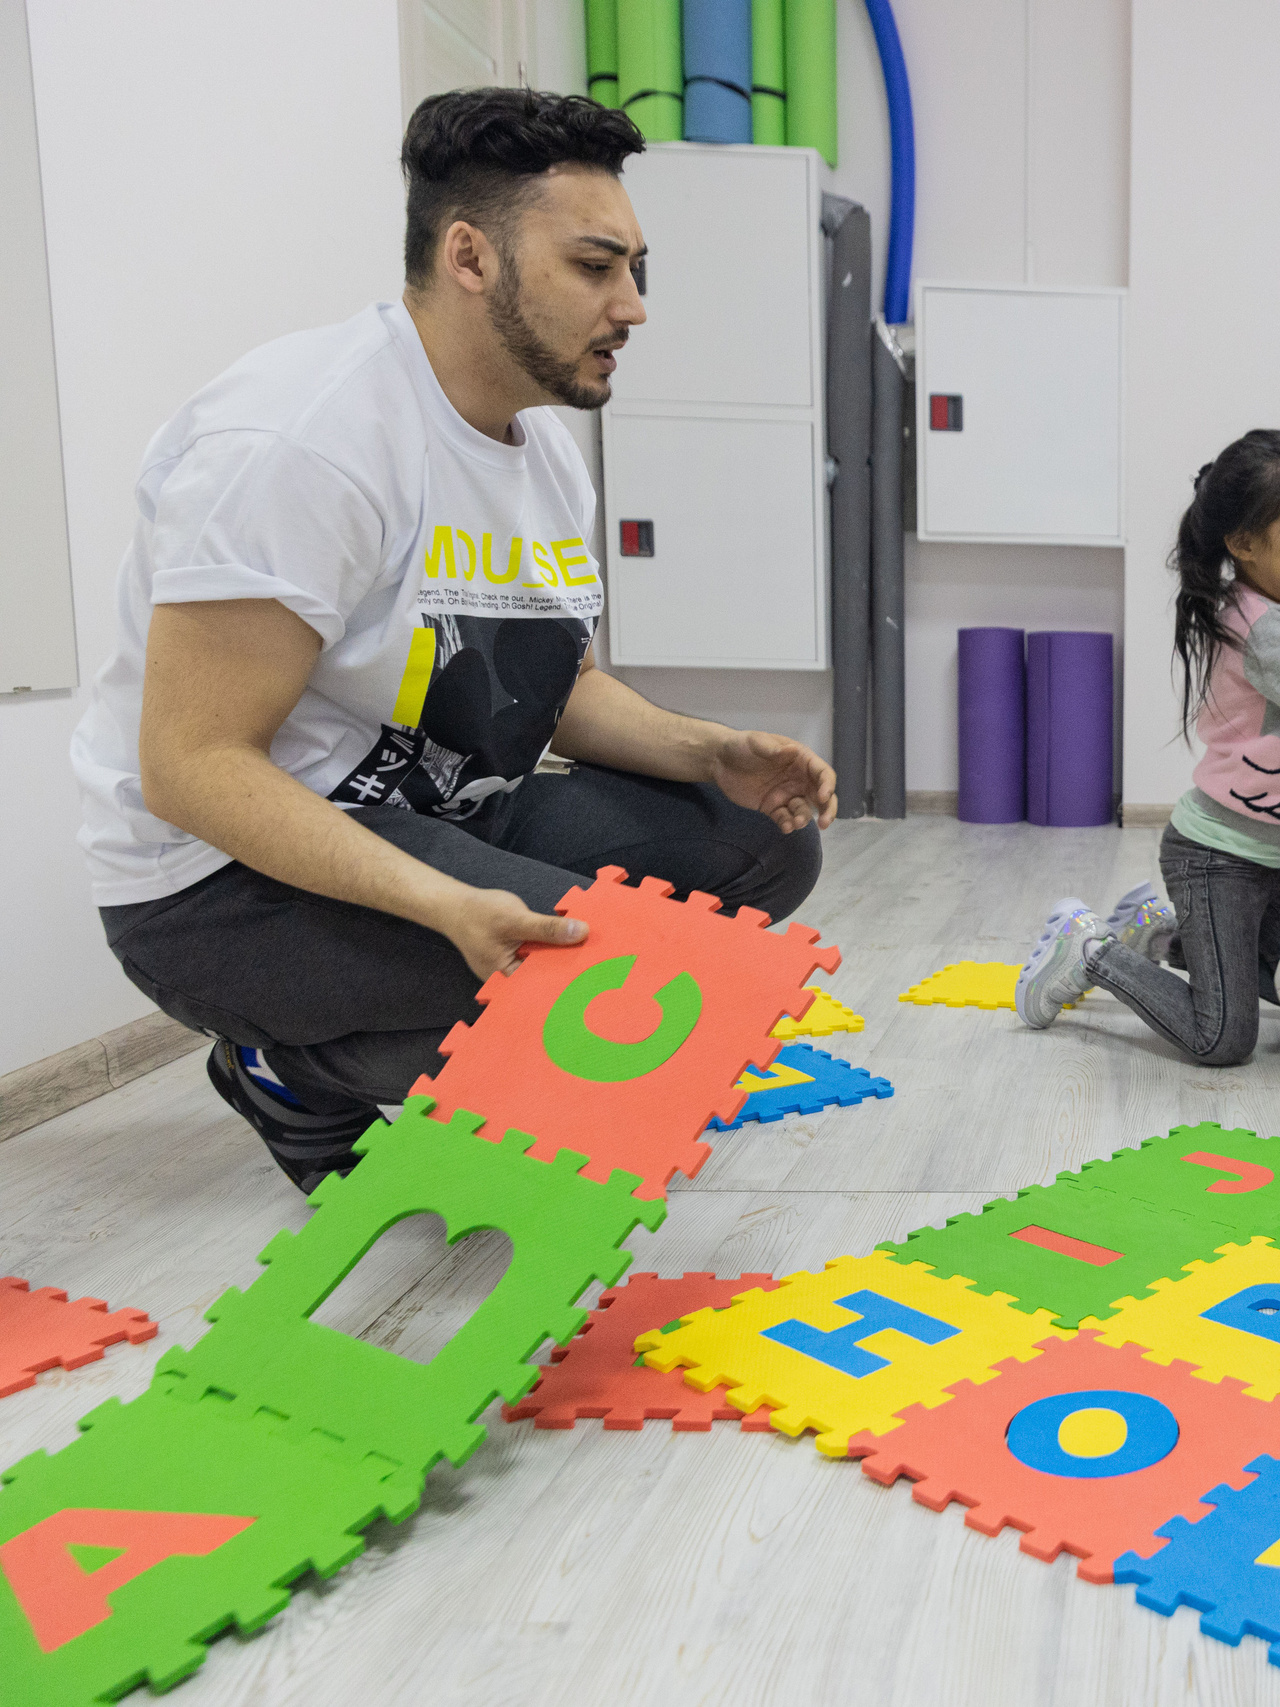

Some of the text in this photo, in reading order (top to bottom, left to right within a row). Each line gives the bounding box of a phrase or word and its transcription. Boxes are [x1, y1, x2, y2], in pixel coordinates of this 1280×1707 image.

[443, 588, 459, 597] The
[480, 592, 498, 601] Check
[529, 596, 554, 604] Mickey
[448, 597, 460, 605] Oh
[501, 601, 511, 609] Oh
[542, 954, 703, 1084] C
[1179, 1150, 1275, 1194] J
[758, 1288, 963, 1379] H
[1004, 1389, 1180, 1479] O
[0, 1506, 259, 1654] A
